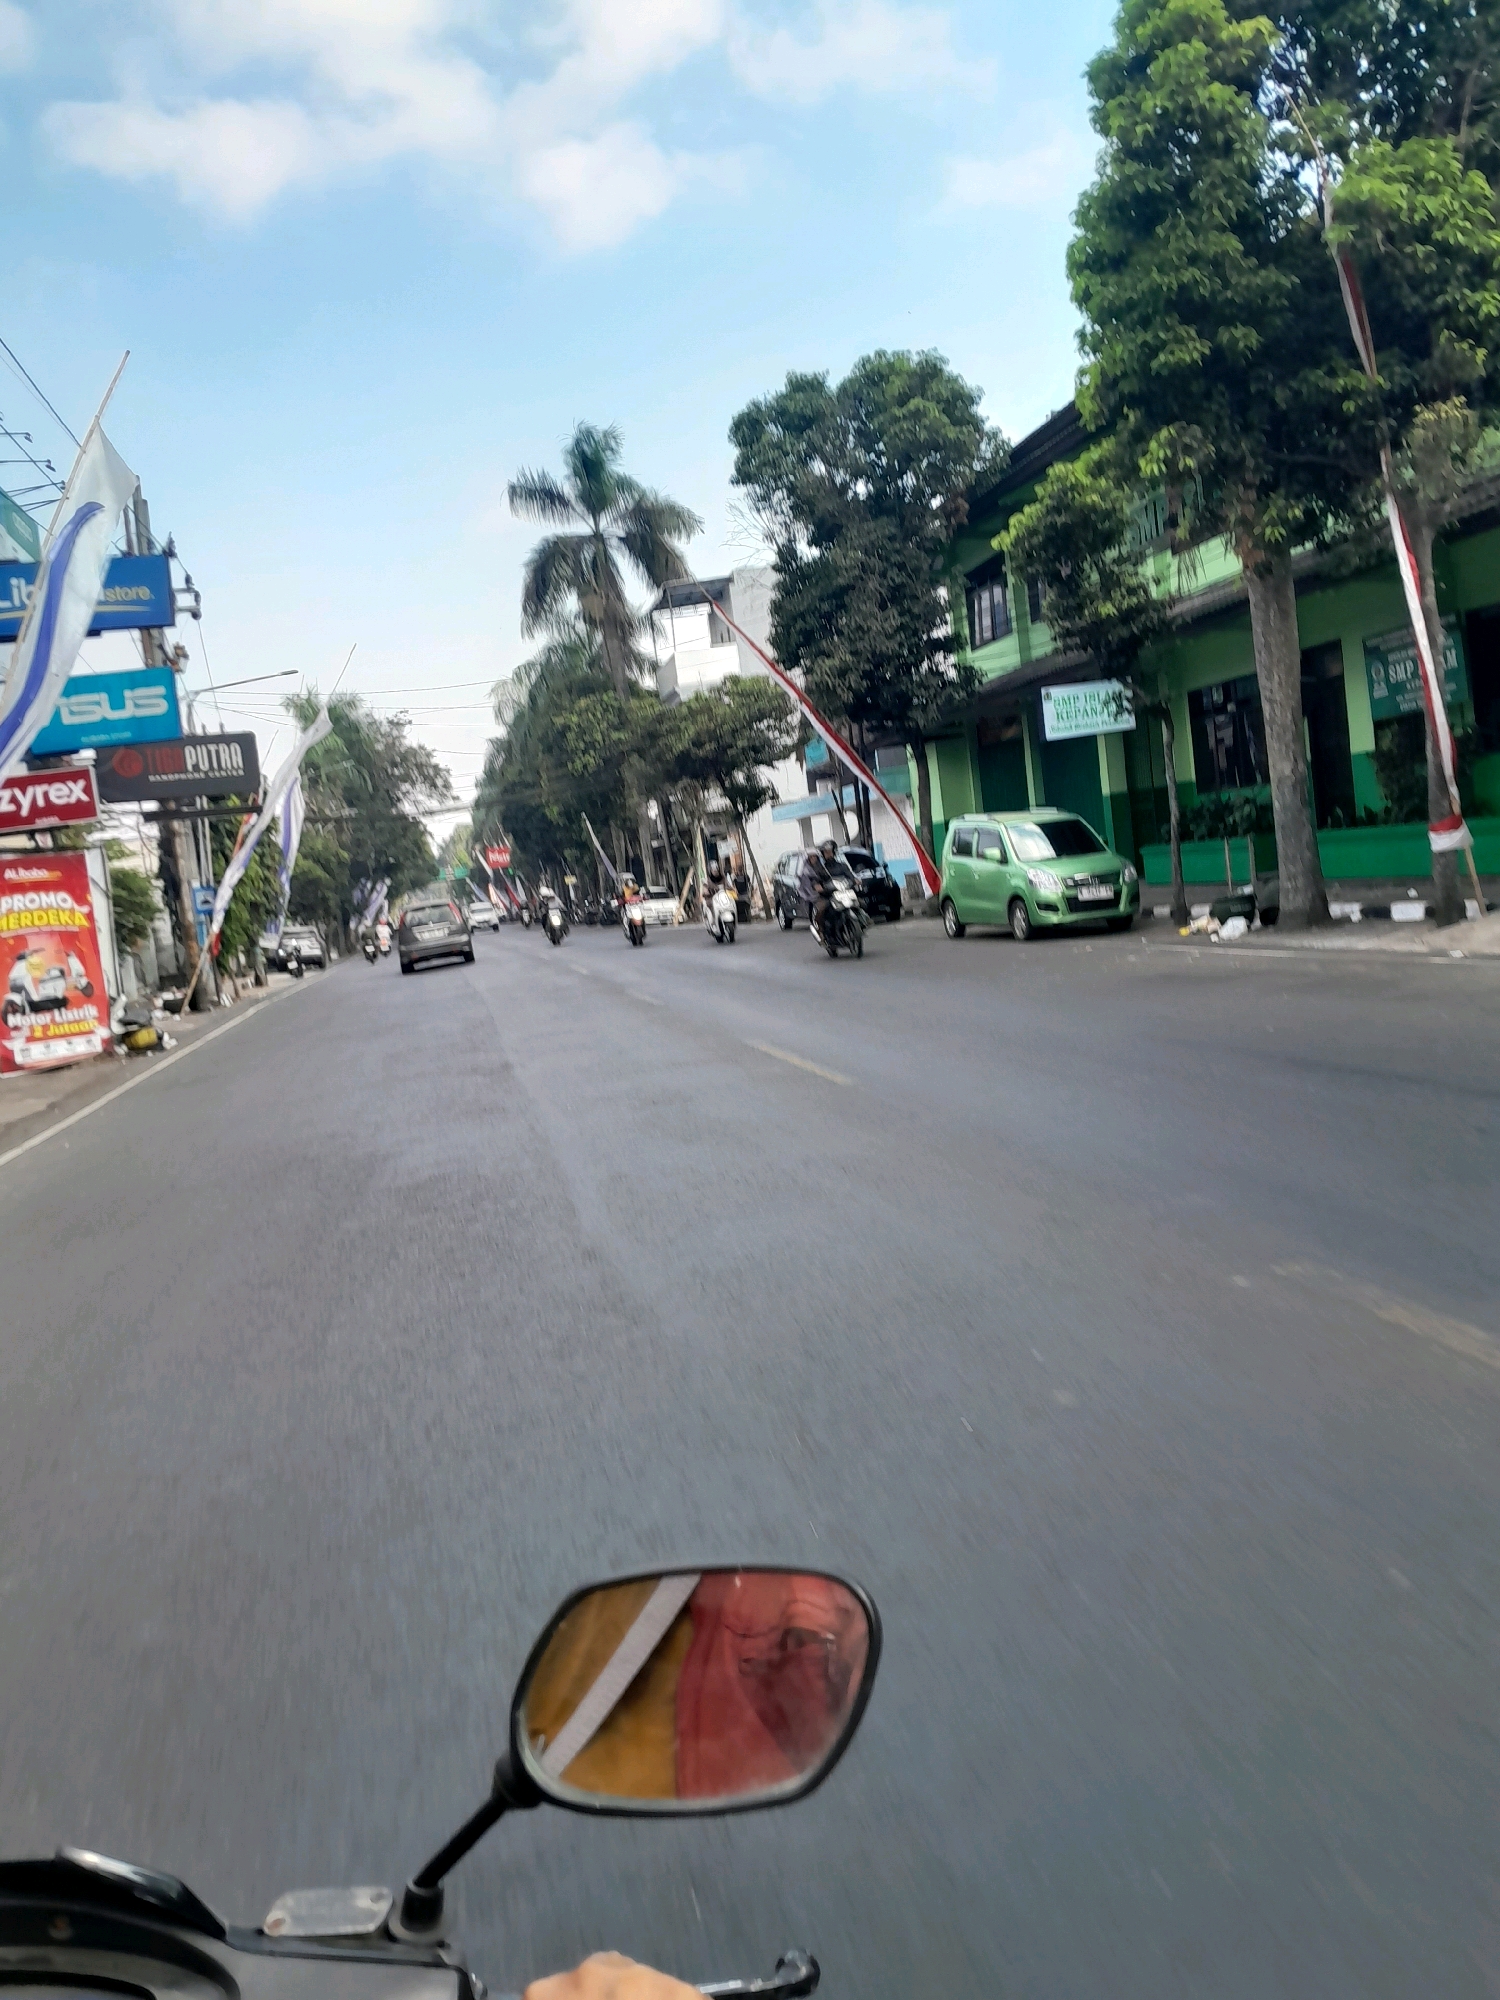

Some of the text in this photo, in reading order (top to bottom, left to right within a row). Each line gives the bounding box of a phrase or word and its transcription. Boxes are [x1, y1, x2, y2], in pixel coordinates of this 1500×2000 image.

[1388, 659, 1414, 684] SMP
[184, 742, 244, 771] PUTRA
[208, 768, 245, 778] CENTER
[0, 779, 91, 817] zyrex
[1, 891, 73, 915] PROMO
